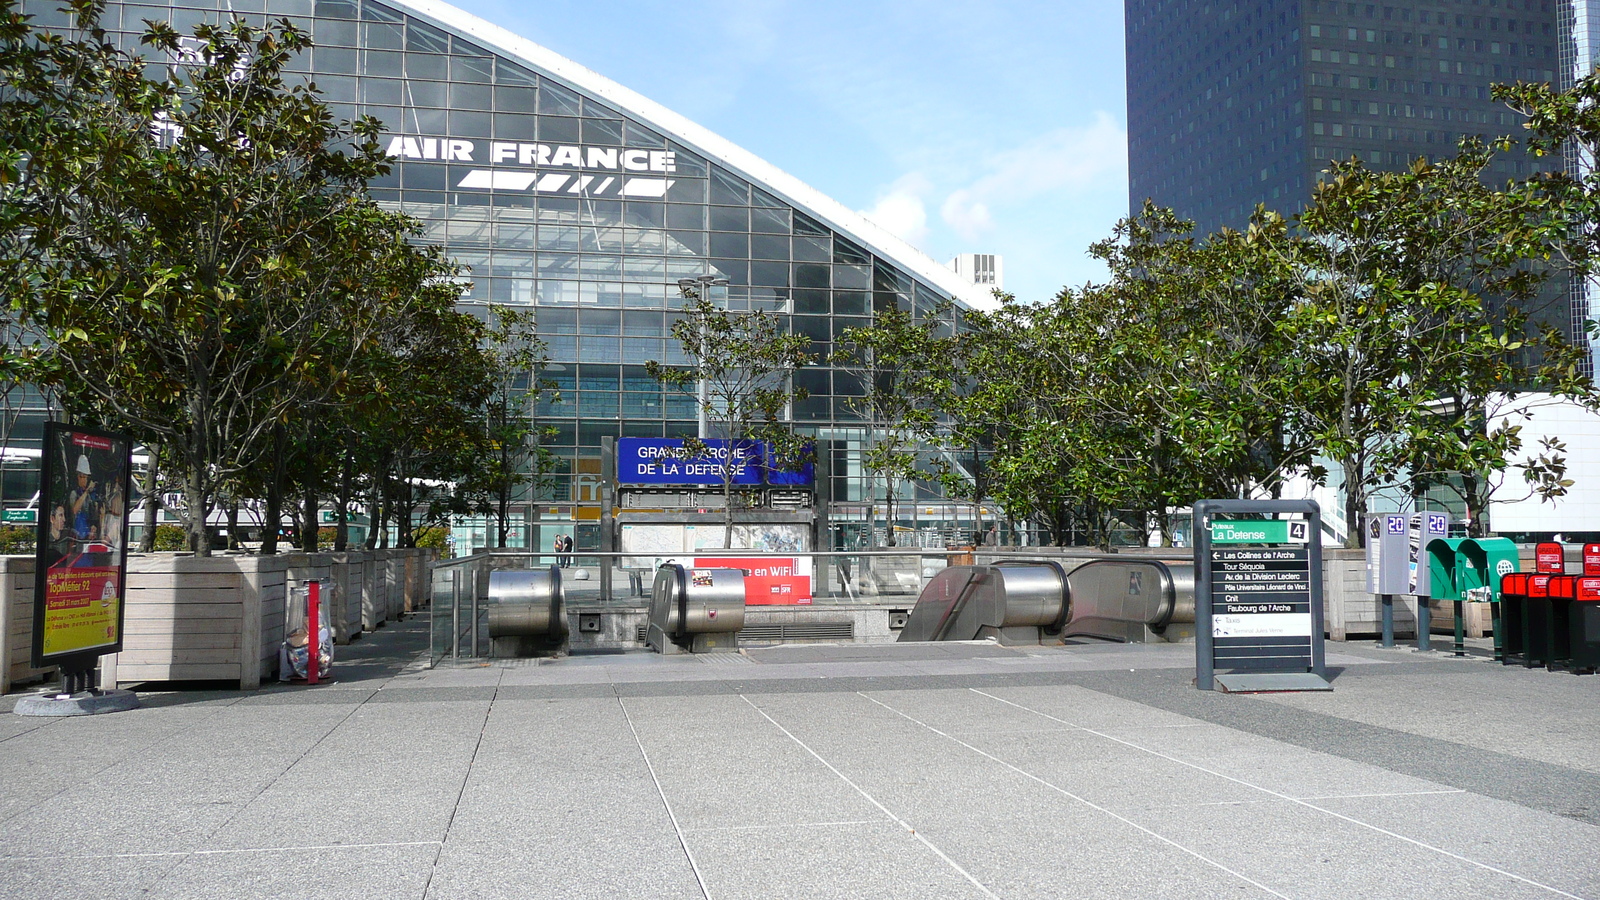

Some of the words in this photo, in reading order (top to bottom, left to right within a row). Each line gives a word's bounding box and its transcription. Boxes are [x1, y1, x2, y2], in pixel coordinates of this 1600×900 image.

[385, 136, 474, 162] AIR
[490, 141, 676, 172] FRANCE
[638, 446, 692, 459] GRAND
[637, 463, 656, 475] DE
[662, 463, 679, 475] LA
[685, 463, 745, 475] DEFENSE
[1388, 517, 1404, 531] 20
[1429, 515, 1445, 531] 20
[1211, 530, 1225, 540] La
[1293, 525, 1302, 538] 4
[1224, 552, 1236, 560] Les
[1237, 552, 1261, 560] Collines
[1262, 552, 1272, 560] de
[754, 568, 767, 577] en
[769, 566, 792, 577] WiFi
[1223, 562, 1238, 571] Tour
[1239, 562, 1265, 572] Séquoia
[1234, 573, 1243, 581] de
[1244, 573, 1251, 581] la
[1277, 572, 1300, 580] Leclerc
[49, 580, 82, 595] TopMétier
[82, 580, 90, 591] 92
[1225, 594, 1239, 602] Cnit
[1227, 605, 1257, 613] Faubourg
[1258, 604, 1268, 612] de
